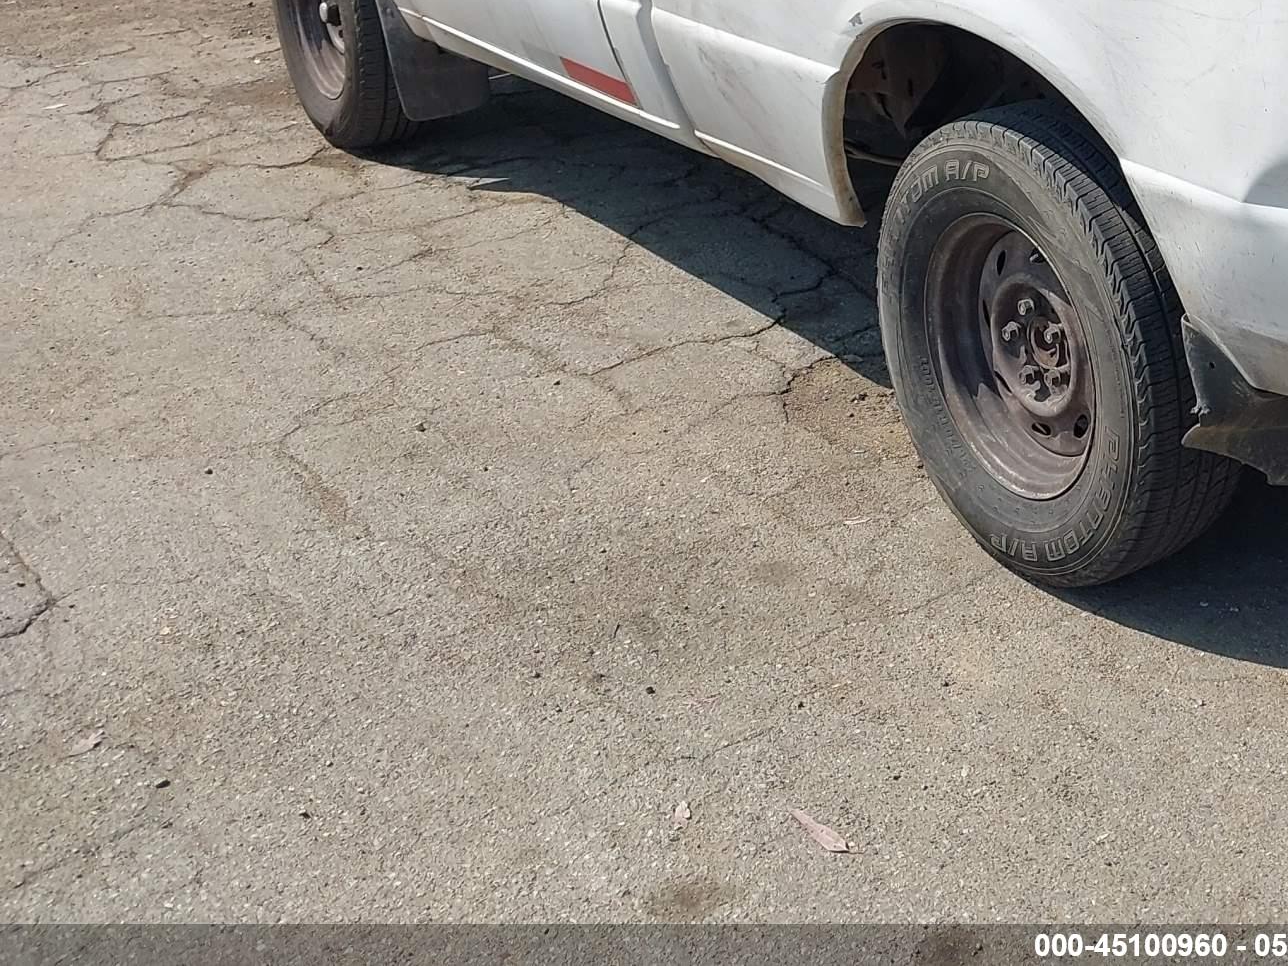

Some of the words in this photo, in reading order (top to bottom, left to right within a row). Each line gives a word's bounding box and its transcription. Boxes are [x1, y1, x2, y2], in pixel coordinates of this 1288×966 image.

[945, 159, 990, 182] A/P
[1044, 425, 1120, 562] PHANTOM
[989, 533, 1038, 562] A/P
